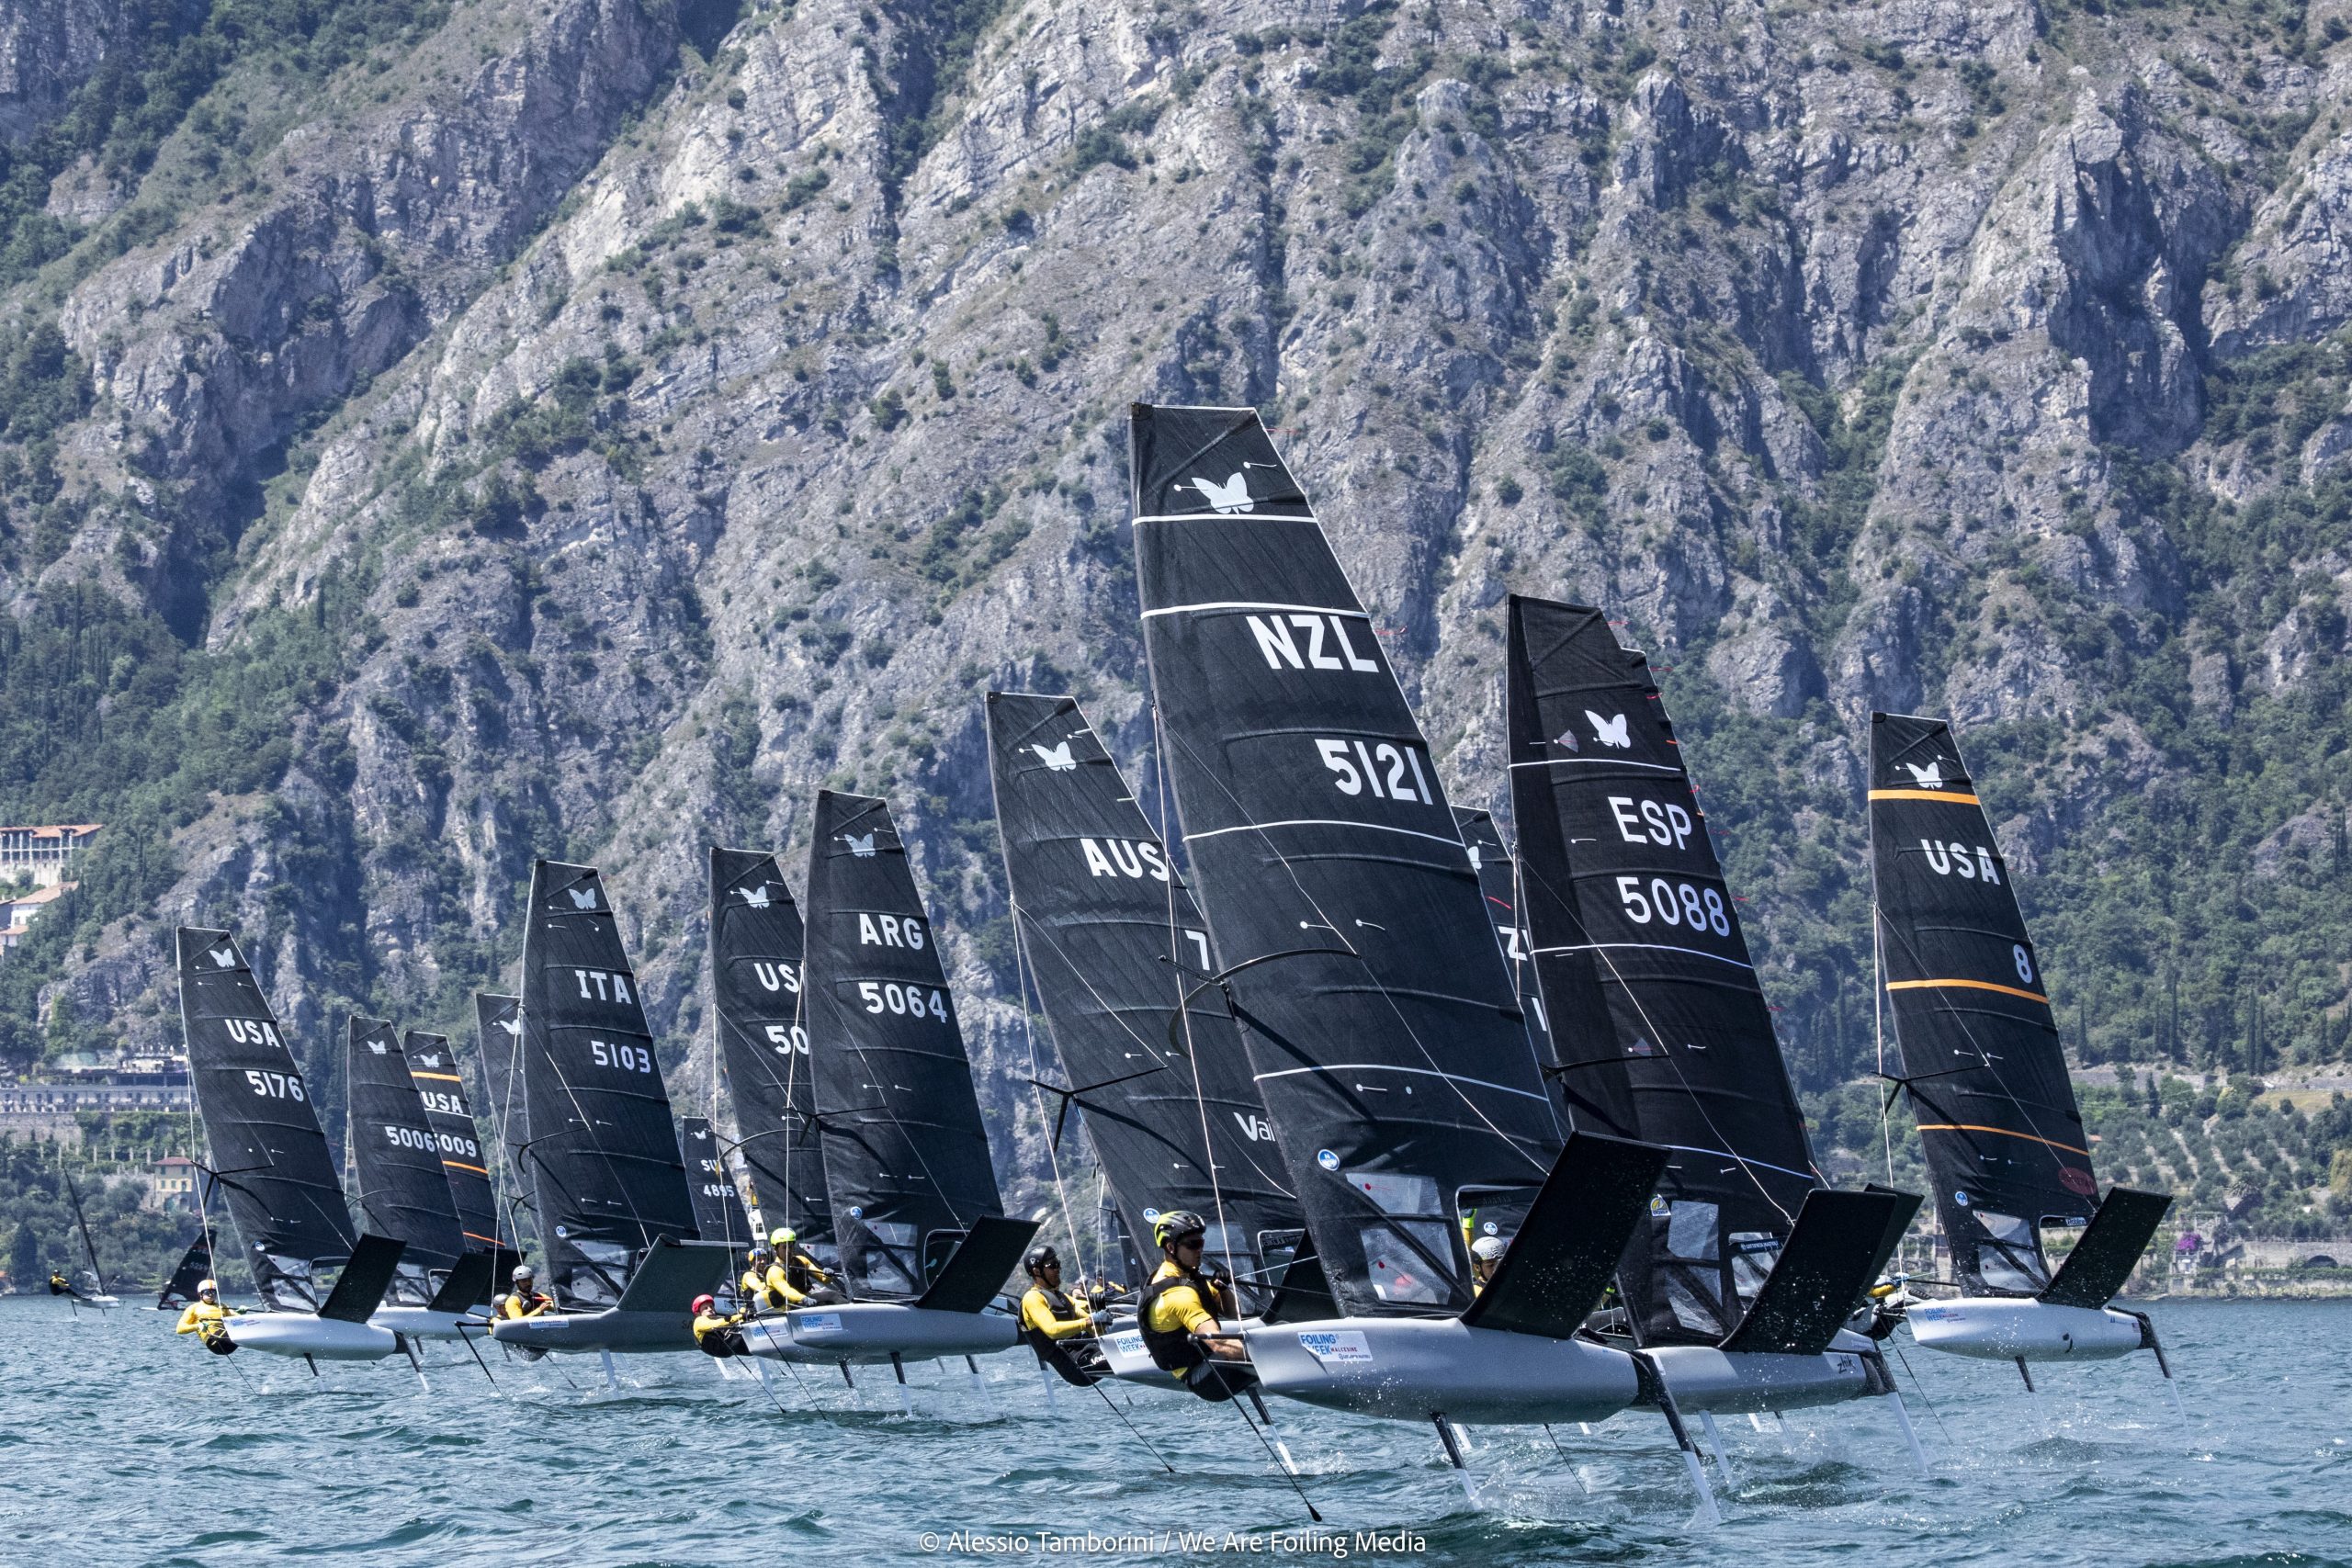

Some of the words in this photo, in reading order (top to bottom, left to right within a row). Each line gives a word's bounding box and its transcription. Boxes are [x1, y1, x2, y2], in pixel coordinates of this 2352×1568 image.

[1246, 615, 1379, 672] NZL
[1315, 739, 1433, 805] 5121
[1608, 796, 1692, 851] ESP
[1080, 838, 1170, 882] AUS
[1920, 839, 2001, 886] USA
[1616, 877, 1730, 937] 5088
[859, 913, 923, 950] ARG
[1184, 930, 1210, 970] 7
[2012, 944, 2032, 984] 8
[575, 970, 632, 1005] ITA
[858, 982, 947, 1023] 5064
[225, 1019, 280, 1048] USA
[591, 1041, 650, 1073] 5103
[245, 1071, 304, 1102] 5176
[420, 1090, 464, 1114] USA
[384, 1125, 435, 1153] 5006
[435, 1133, 477, 1157] 009
[1117, 1334, 1144, 1346] FOILING
[1121, 1344, 1140, 1353] WEEK
[1300, 1334, 1337, 1345] FOILING
[1308, 1345, 1332, 1355] EEK
